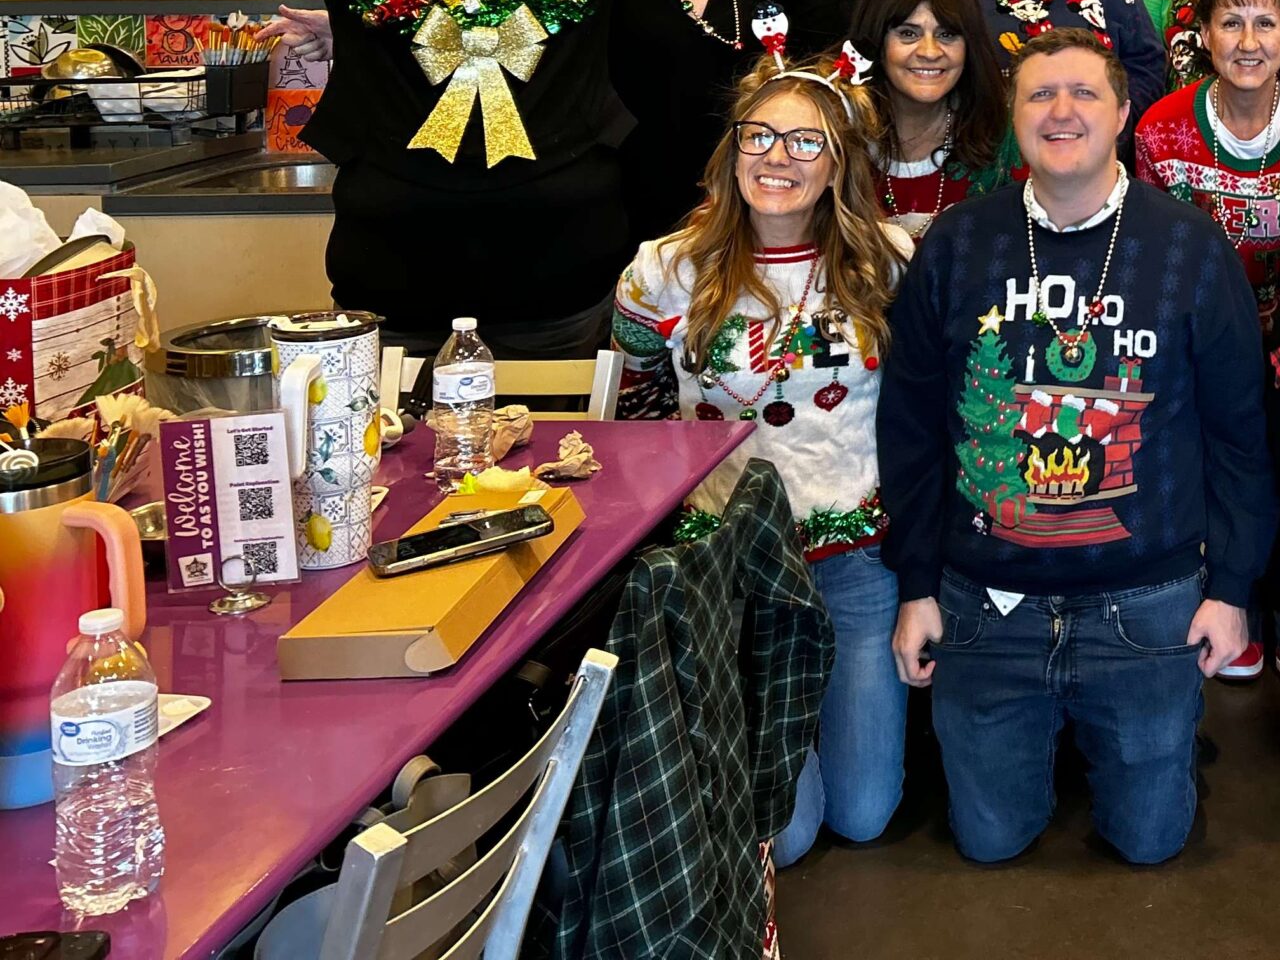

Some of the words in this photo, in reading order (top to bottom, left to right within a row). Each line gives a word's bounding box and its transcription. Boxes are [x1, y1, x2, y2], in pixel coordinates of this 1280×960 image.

[154, 52, 200, 65] Taurus
[1005, 274, 1076, 322] HO
[1077, 294, 1125, 327] HO
[1113, 329, 1157, 358] HO
[191, 423, 208, 469] WISH!
[168, 435, 200, 538] Welcome
[196, 470, 210, 503] YOU
[198, 507, 212, 525] AS
[202, 527, 214, 549] TO
[76, 734, 113, 745] Drinking
